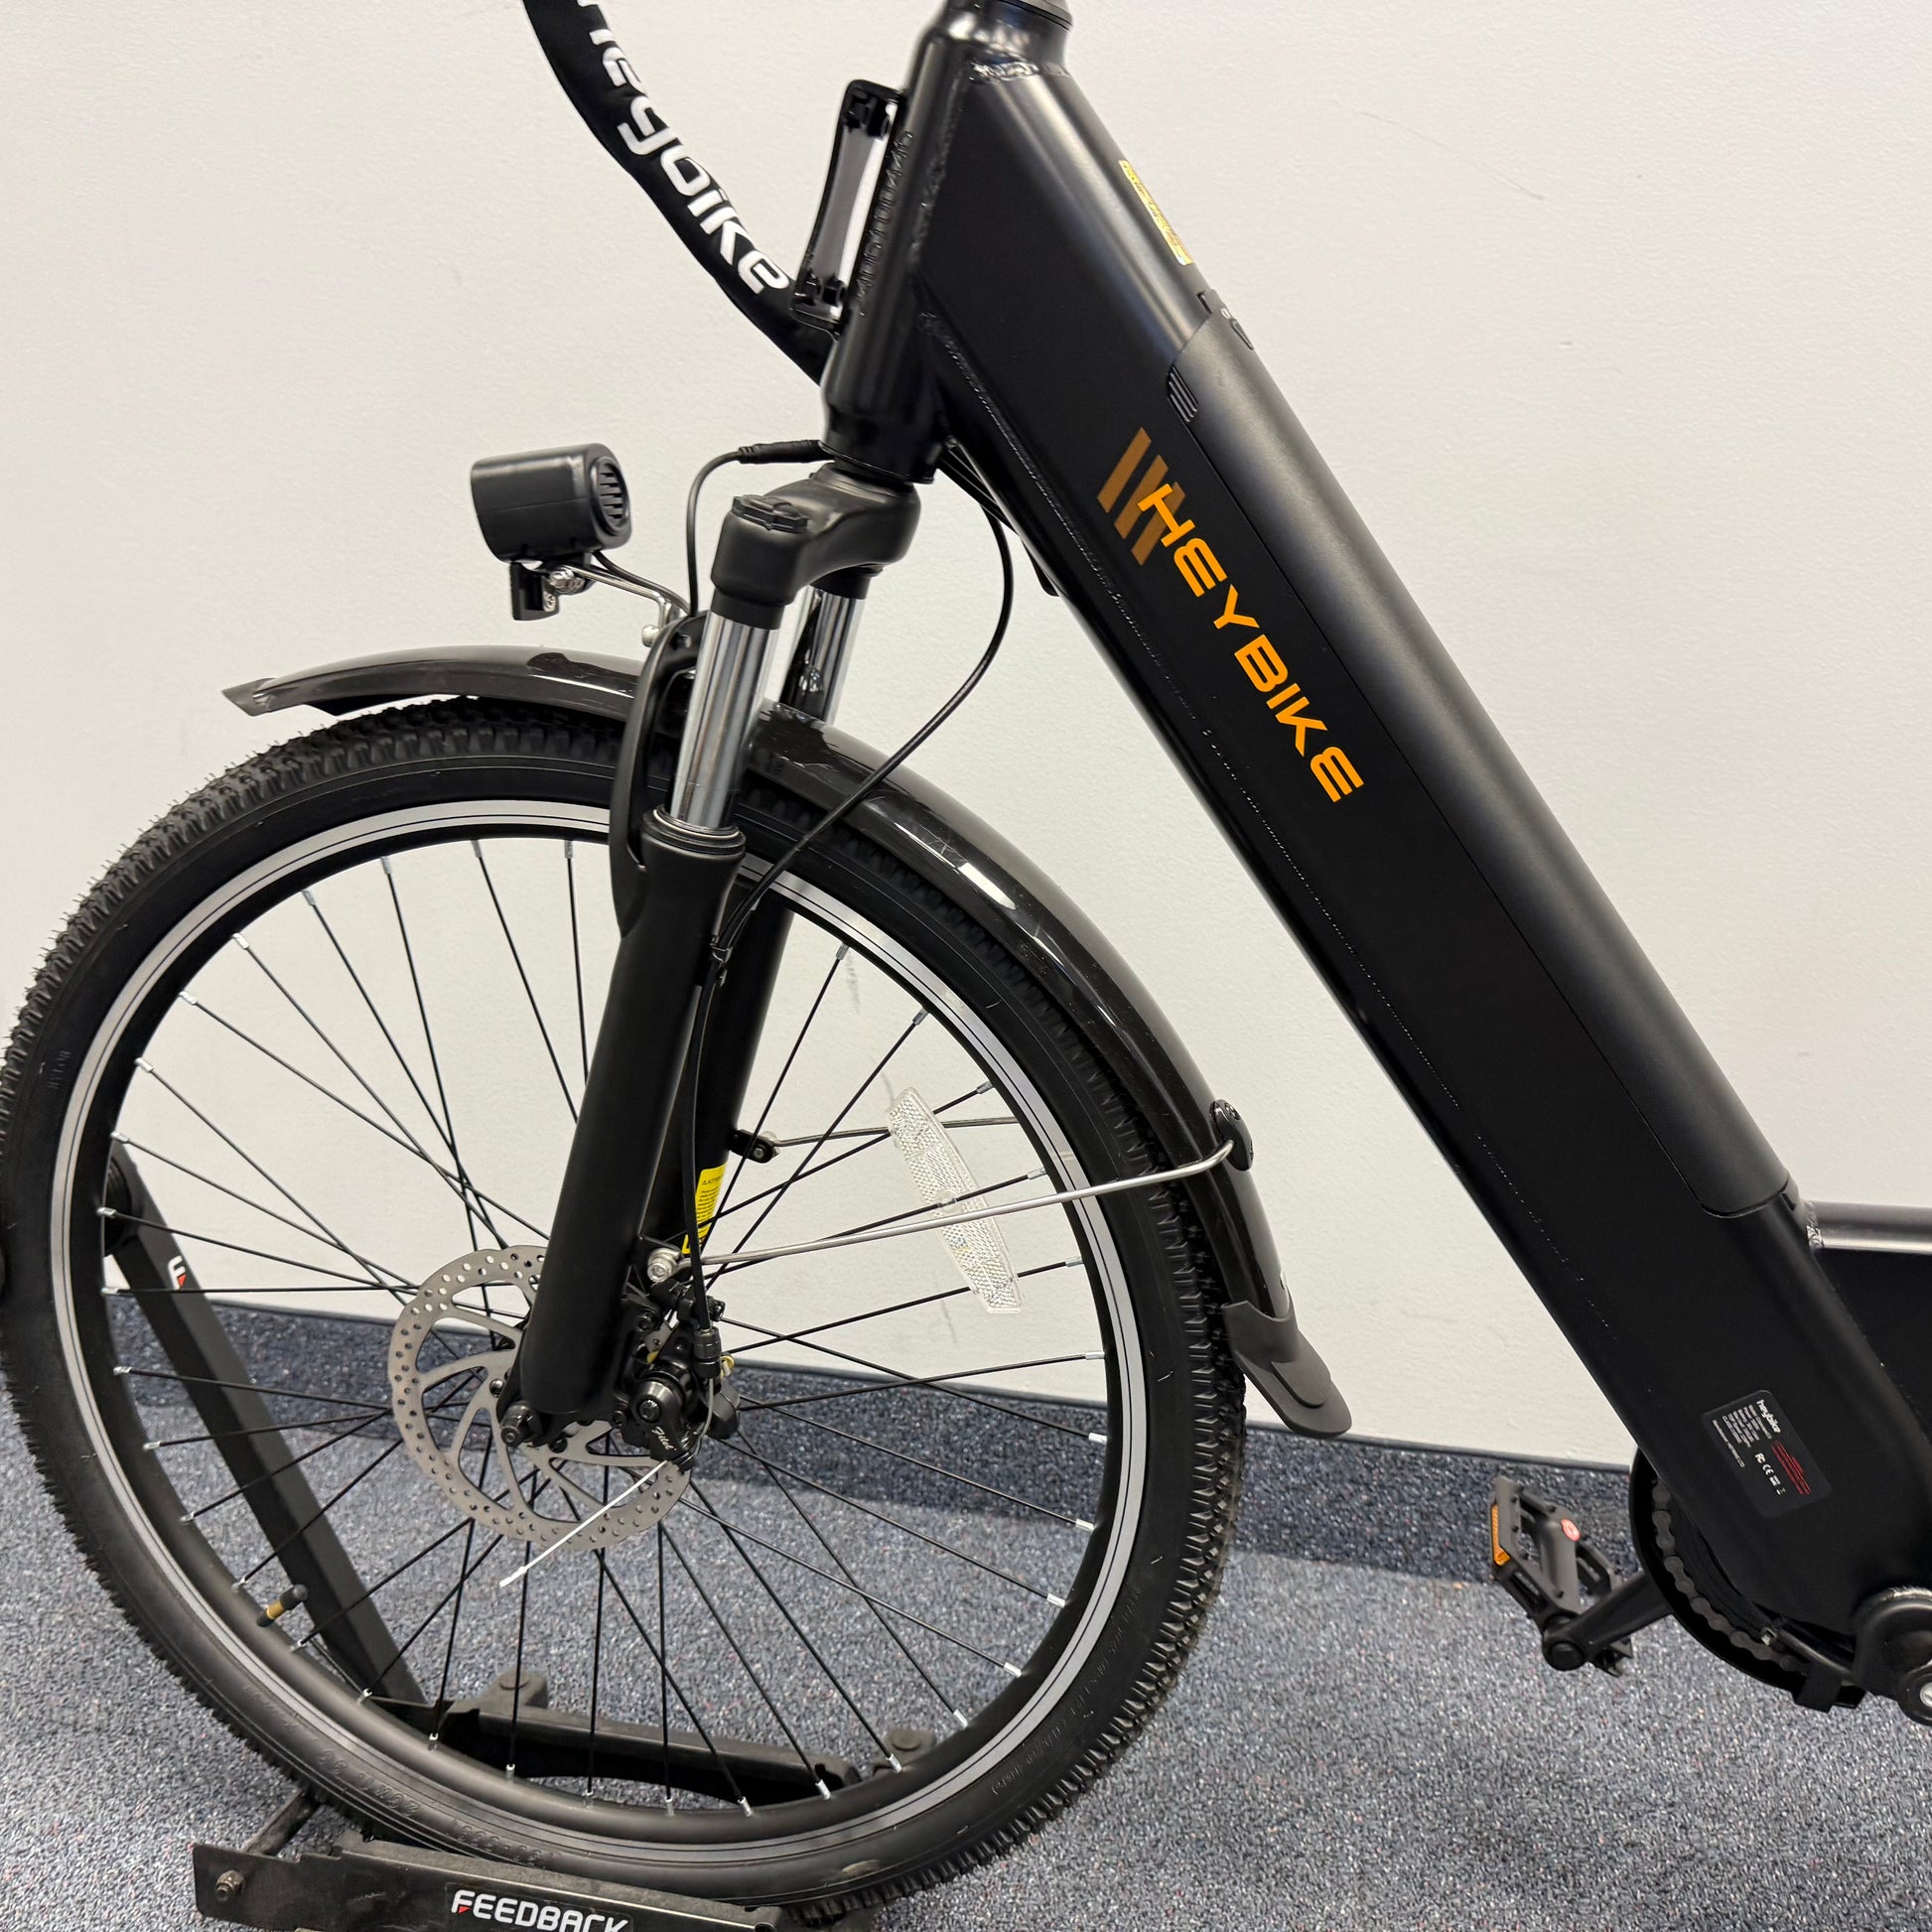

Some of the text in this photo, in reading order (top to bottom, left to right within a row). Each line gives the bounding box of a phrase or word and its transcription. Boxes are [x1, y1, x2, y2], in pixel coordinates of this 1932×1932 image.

[1138, 483, 1365, 803] HEYBIKE
[1756, 1399, 1781, 1434] heybike
[451, 1889, 629, 1932] FEEDBACK
